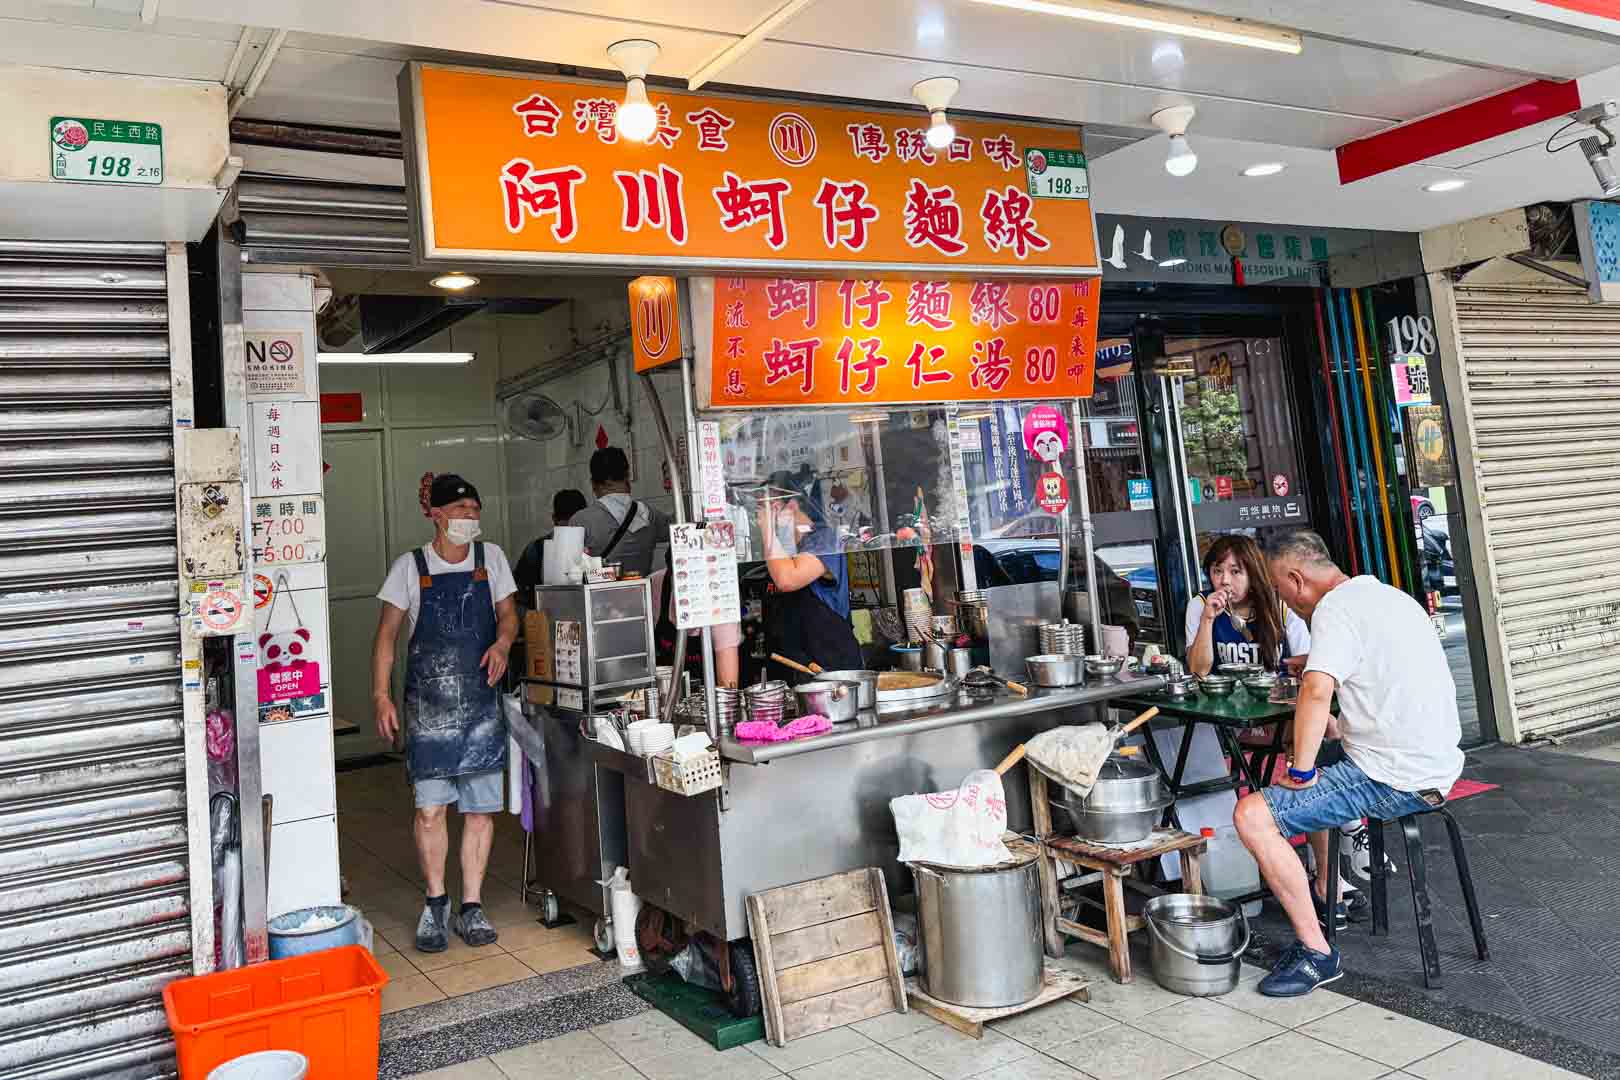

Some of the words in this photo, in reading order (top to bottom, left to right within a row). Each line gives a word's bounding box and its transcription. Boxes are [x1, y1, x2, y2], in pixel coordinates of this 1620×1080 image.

[93, 122, 159, 140] 民生西路
[87, 155, 132, 177] 198
[136, 167, 160, 177] 之16
[1047, 177, 1072, 195] 198
[500, 158, 1051, 260] 阿川蚵仔麵線
[765, 279, 1016, 329] 蚵仔麵線
[1026, 286, 1061, 322] 80
[1386, 315, 1436, 355] 198
[763, 337, 1012, 394] 蚵仔仁湯
[1024, 346, 1057, 384] 80
[267, 407, 284, 490] 每週日公休
[270, 670, 304, 685] 營業中
[275, 682, 299, 692] OPEN
